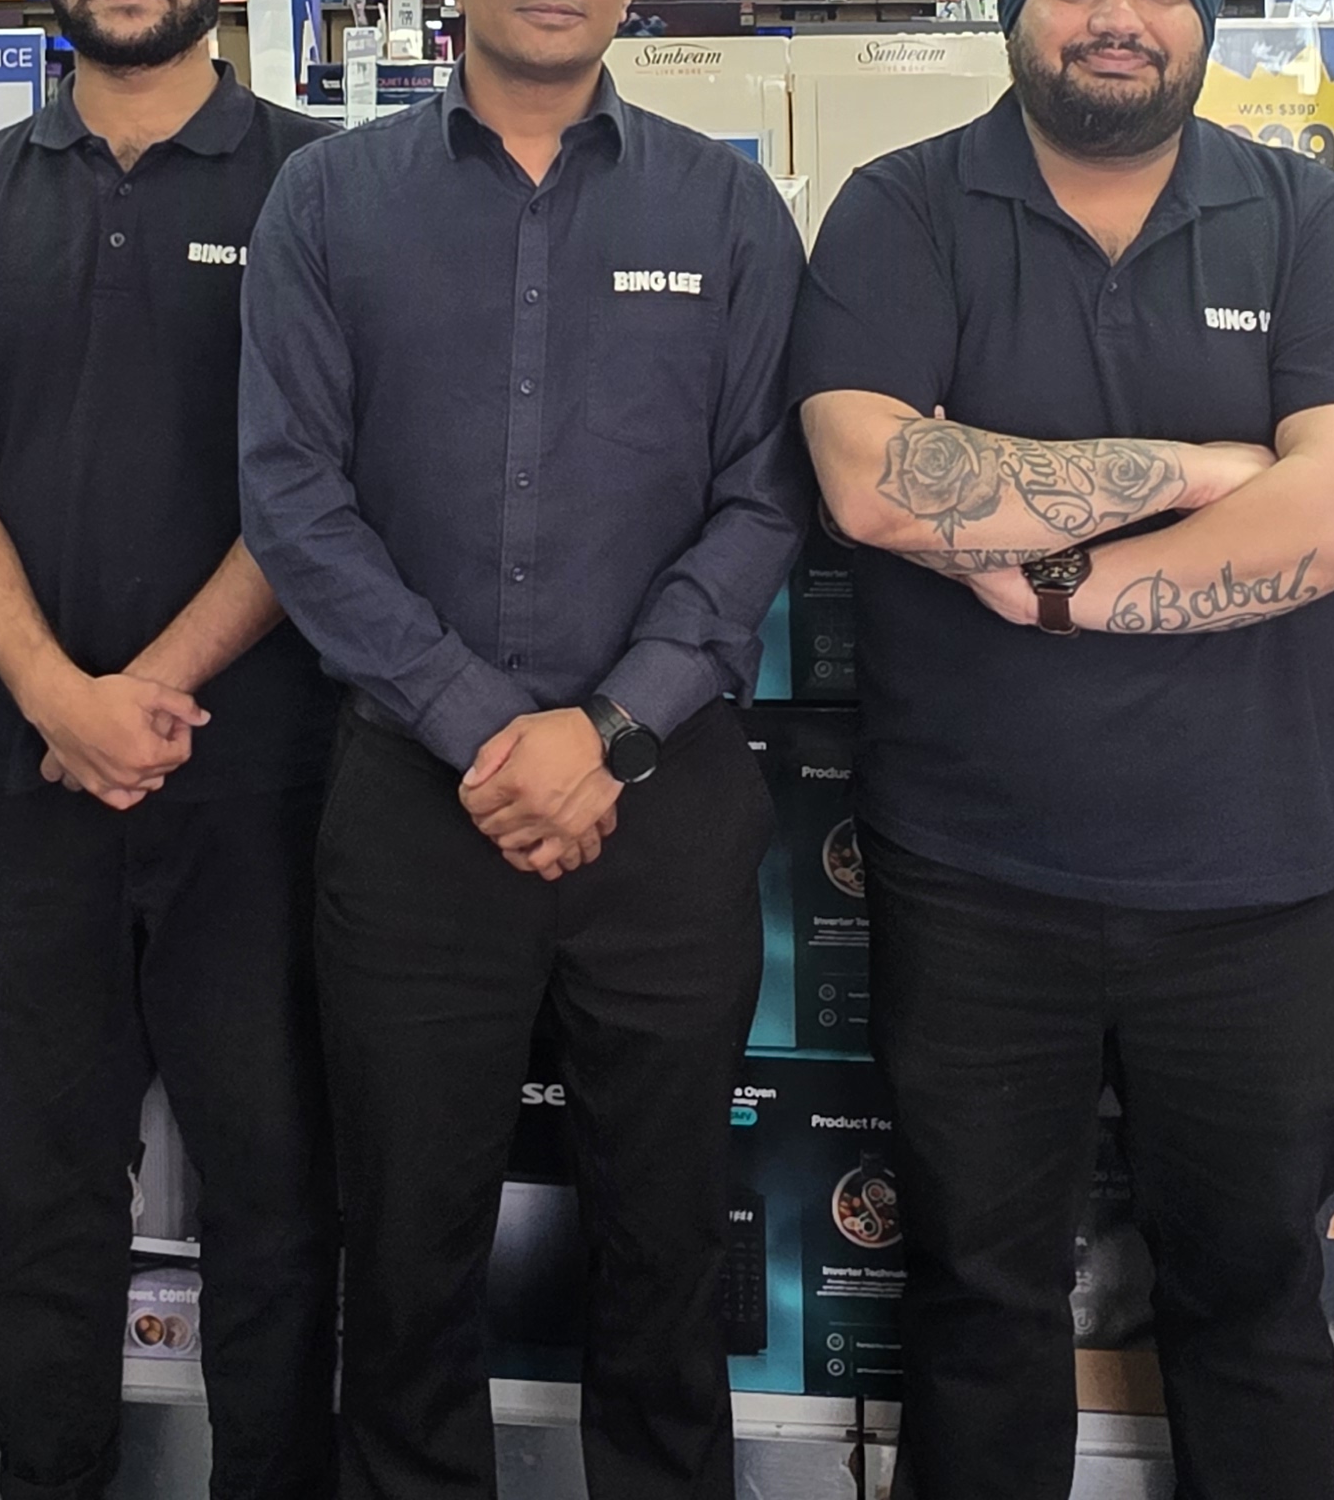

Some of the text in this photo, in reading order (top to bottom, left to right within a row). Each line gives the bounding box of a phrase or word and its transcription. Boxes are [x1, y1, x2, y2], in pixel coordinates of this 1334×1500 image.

[635, 44, 722, 67] Sunbeam
[858, 41, 946, 65] Sunbeam
[411, 78, 432, 86] EASY
[1238, 104, 1273, 115] WAS
[188, 242, 237, 265] BING
[614, 270, 702, 295] BING LEE
[1204, 307, 1257, 331] BING
[801, 766, 852, 779] Produc
[811, 1114, 868, 1130] Product
